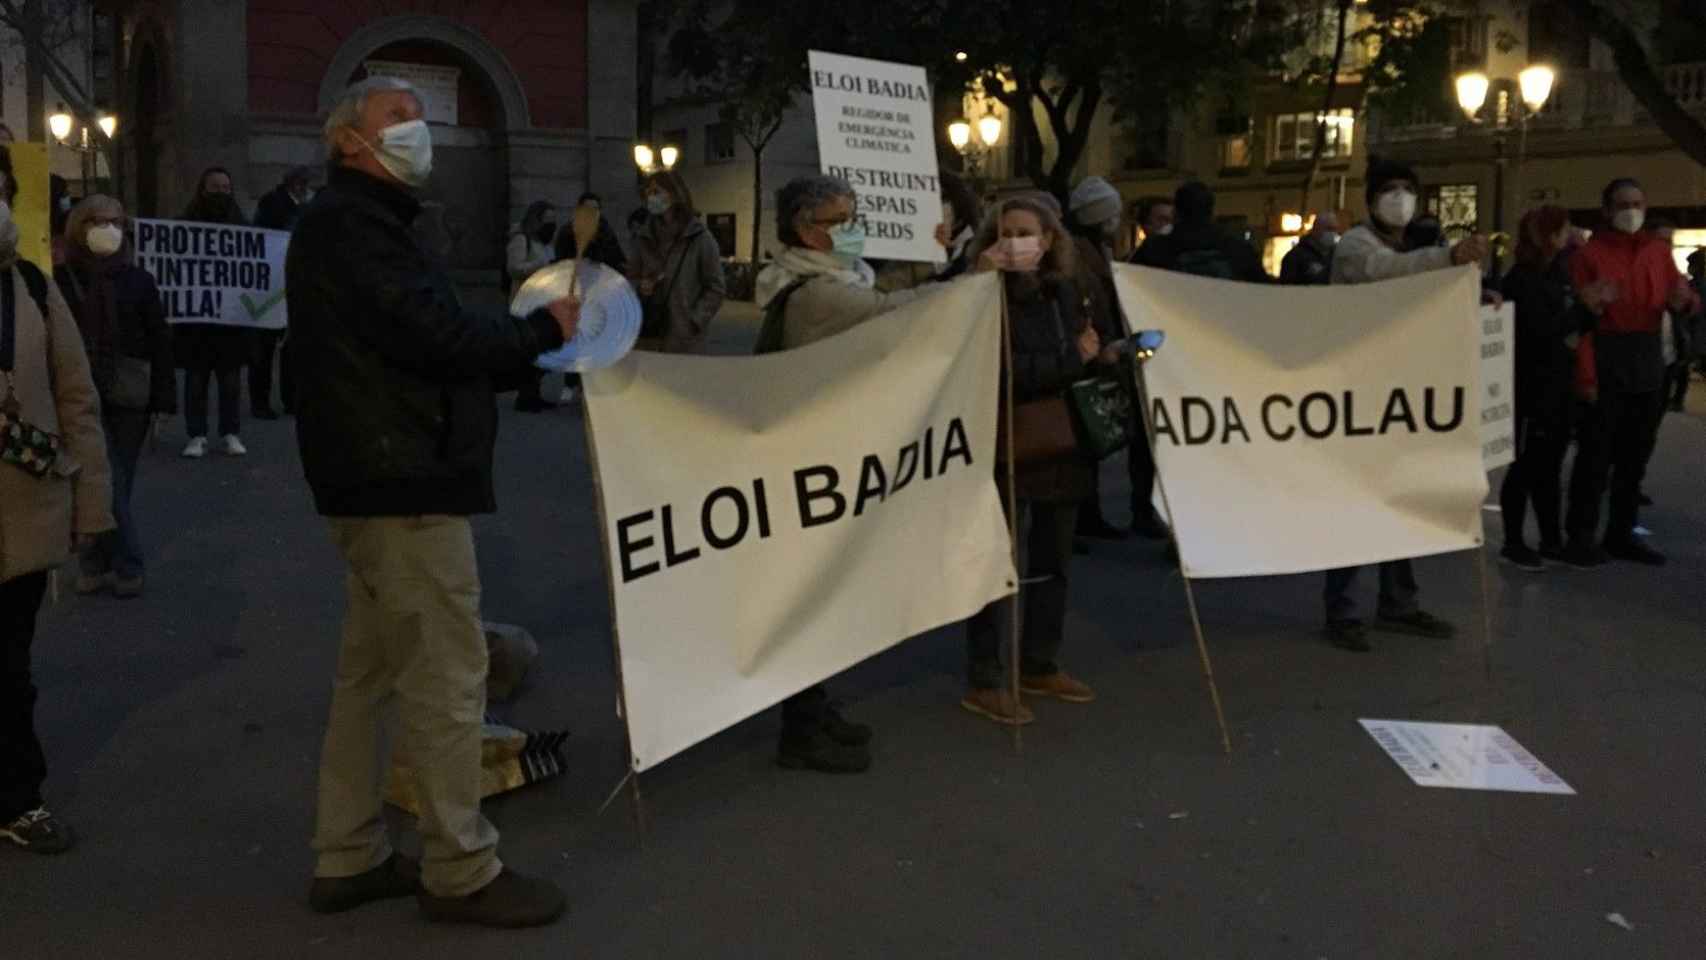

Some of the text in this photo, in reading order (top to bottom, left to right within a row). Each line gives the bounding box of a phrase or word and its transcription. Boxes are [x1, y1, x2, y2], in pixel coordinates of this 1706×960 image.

[814, 69, 927, 102] ELOI BADIA
[842, 105, 911, 123] REGIDOR DE
[828, 165, 940, 192] DESTRUINT
[138, 222, 266, 259] PROTEGIM
[862, 219, 914, 241] ERDS
[162, 290, 222, 319] ILLA!
[1152, 396, 1251, 446] ADA
[1261, 386, 1465, 442] COLAU
[616, 416, 974, 583] ELOI BADIA
